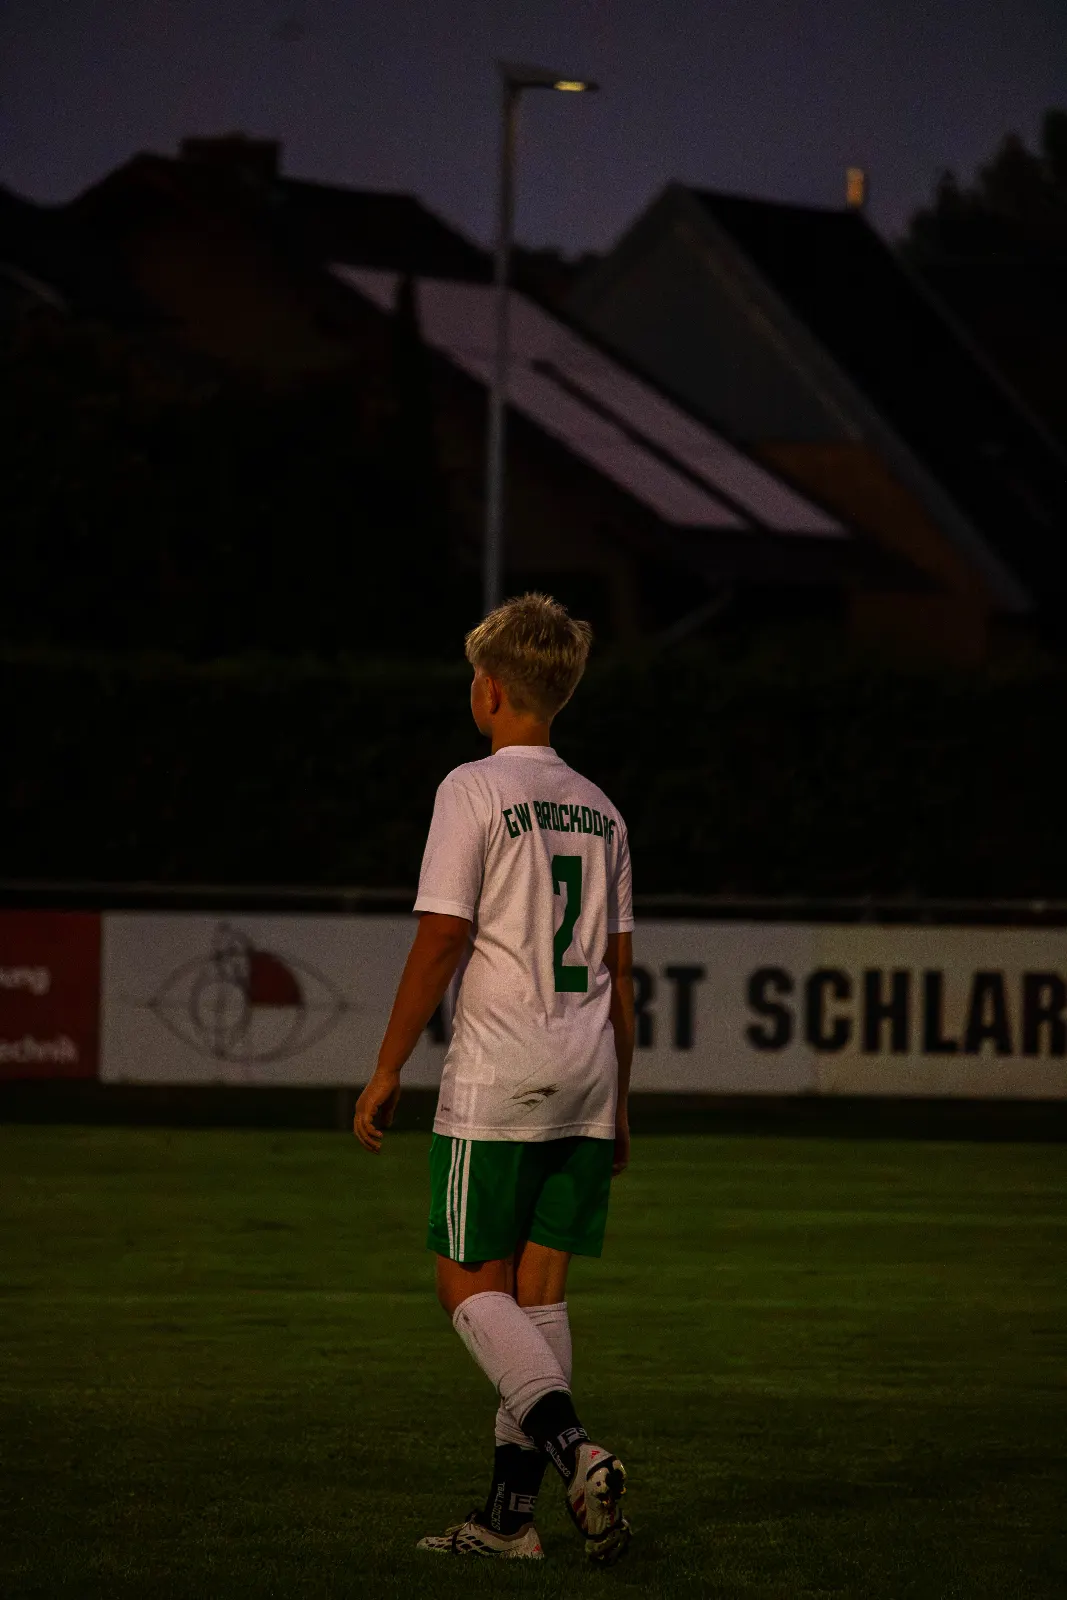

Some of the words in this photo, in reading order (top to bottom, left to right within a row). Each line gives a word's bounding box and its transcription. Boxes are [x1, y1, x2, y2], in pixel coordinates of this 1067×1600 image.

[502, 802, 533, 839] GW
[533, 800, 616, 844] BROCKDORF
[551, 854, 589, 993] 2
